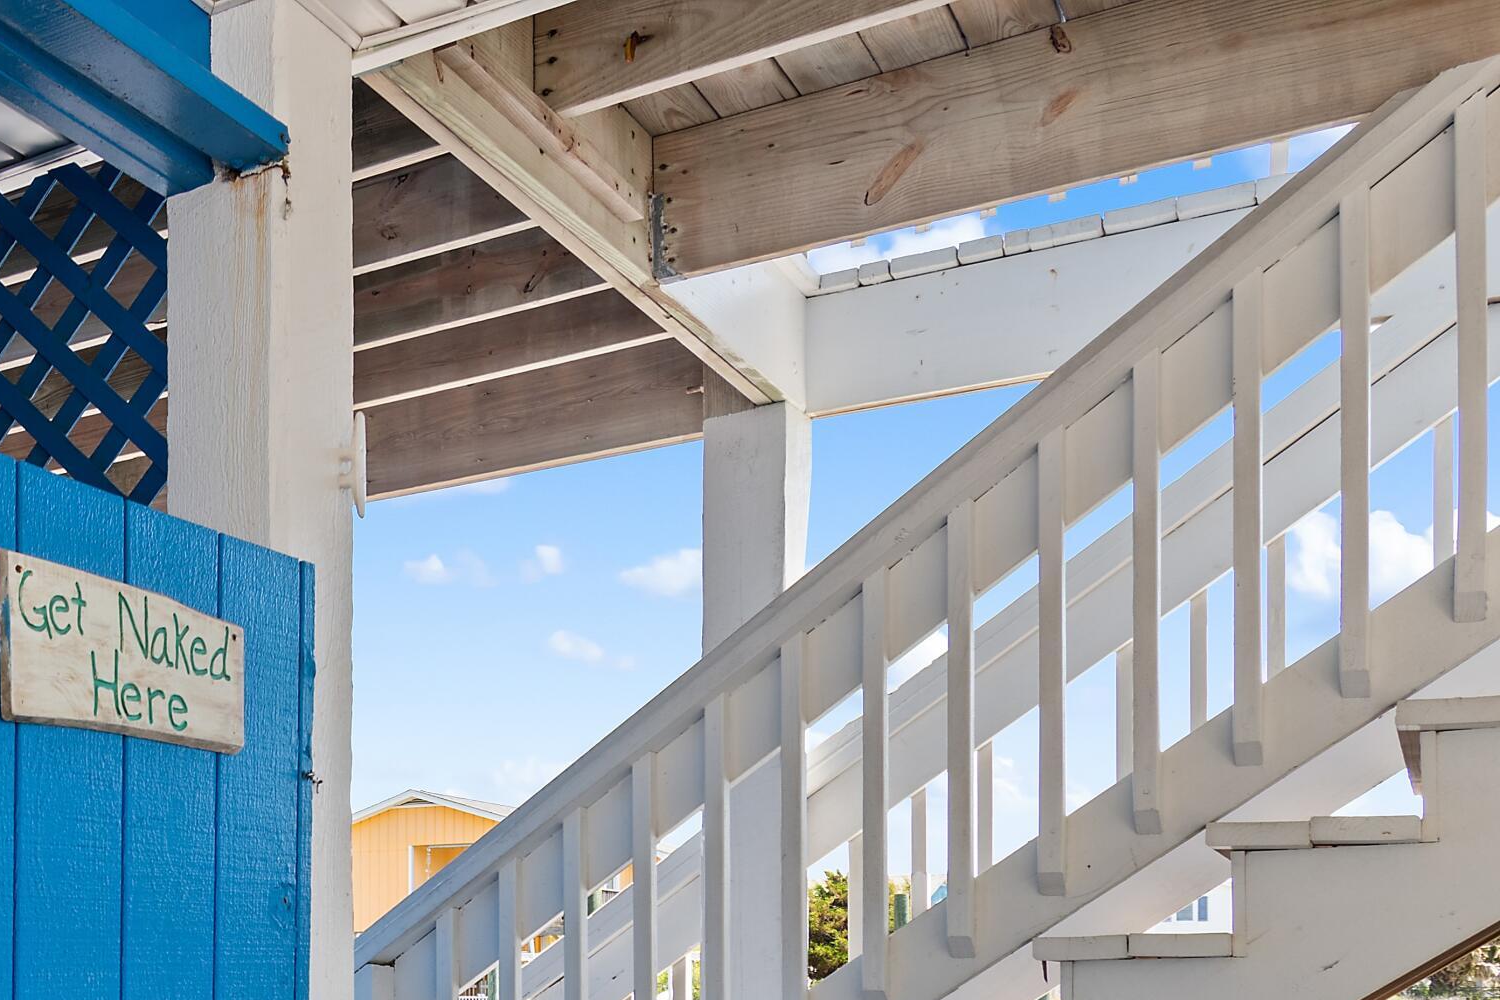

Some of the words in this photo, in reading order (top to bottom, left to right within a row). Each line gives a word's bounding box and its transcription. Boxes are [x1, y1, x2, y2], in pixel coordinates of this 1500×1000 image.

[18, 570, 87, 639] Get
[118, 591, 231, 681] Naked
[91, 649, 188, 731] Here
